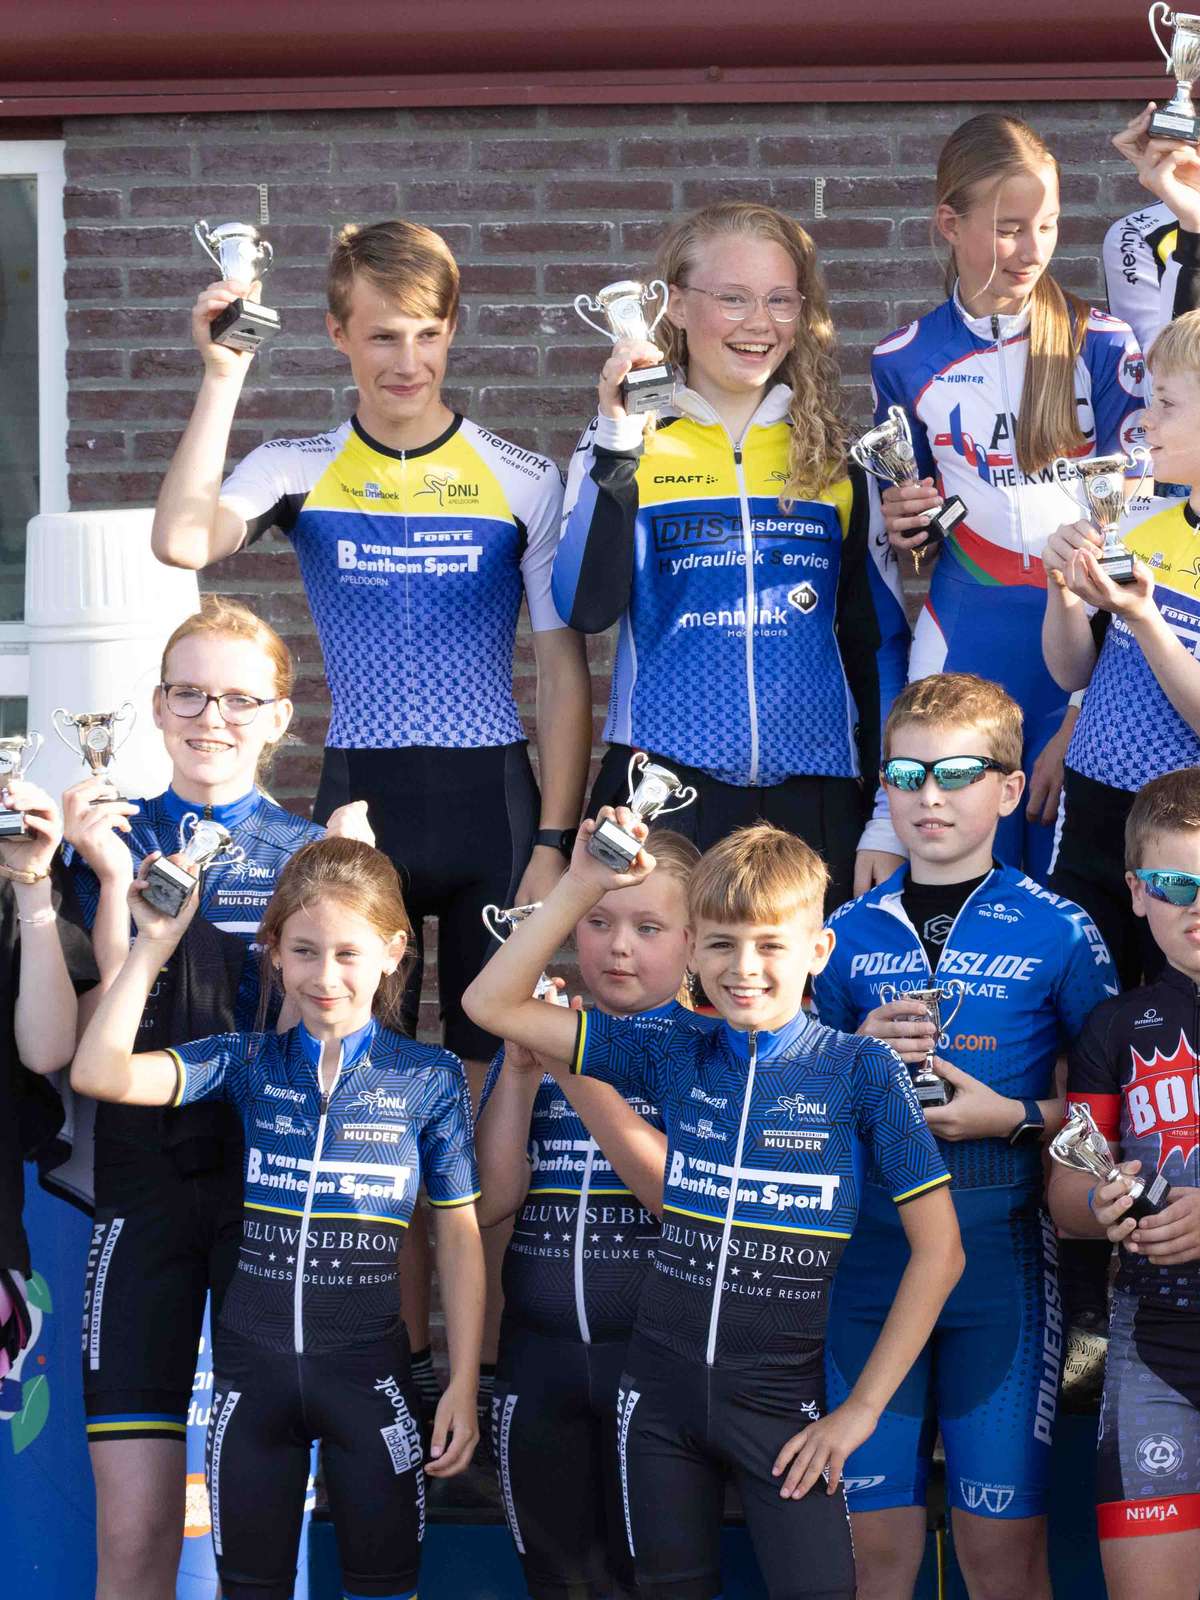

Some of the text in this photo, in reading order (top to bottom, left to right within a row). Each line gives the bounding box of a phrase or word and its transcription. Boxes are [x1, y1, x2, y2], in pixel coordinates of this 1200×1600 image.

[947, 374, 984, 385] HUNTER
[475, 428, 553, 474] mennink
[499, 455, 541, 482] Makelaars
[653, 474, 704, 485] CRAFT
[447, 484, 479, 498] DNIJ
[660, 517, 725, 544] DHS
[337, 539, 423, 574] Benthem
[361, 543, 392, 556] van
[770, 549, 830, 570] Service
[341, 575, 390, 586] APELDOORN
[679, 606, 788, 629] mennink
[248, 867, 276, 879] DNIJ
[218, 896, 269, 906] MULDER
[978, 909, 1019, 924] mc cargo
[1015, 874, 1112, 967] MATTER
[850, 948, 1044, 982] POWERSLIDE
[899, 980, 929, 993] LOVE
[377, 1097, 407, 1110] DNIJ
[895, 1072, 922, 1125] Makelaars
[796, 1102, 827, 1115] DNIJ
[343, 1131, 400, 1144] MULDER
[543, 1139, 573, 1151] van
[764, 1137, 822, 1151] MULDER
[266, 1153, 299, 1169] van
[688, 1157, 717, 1175] van
[246, 1147, 336, 1195] Benthem
[667, 1151, 758, 1203] Benthem
[522, 1205, 578, 1224] ELUW
[583, 1249, 640, 1260] DELUXE
[302, 1273, 353, 1286] DELUXE
[721, 1280, 773, 1298] DELUXE
[778, 1288, 822, 1300] RESORT
[1033, 1207, 1065, 1447] POWERSLIDE
